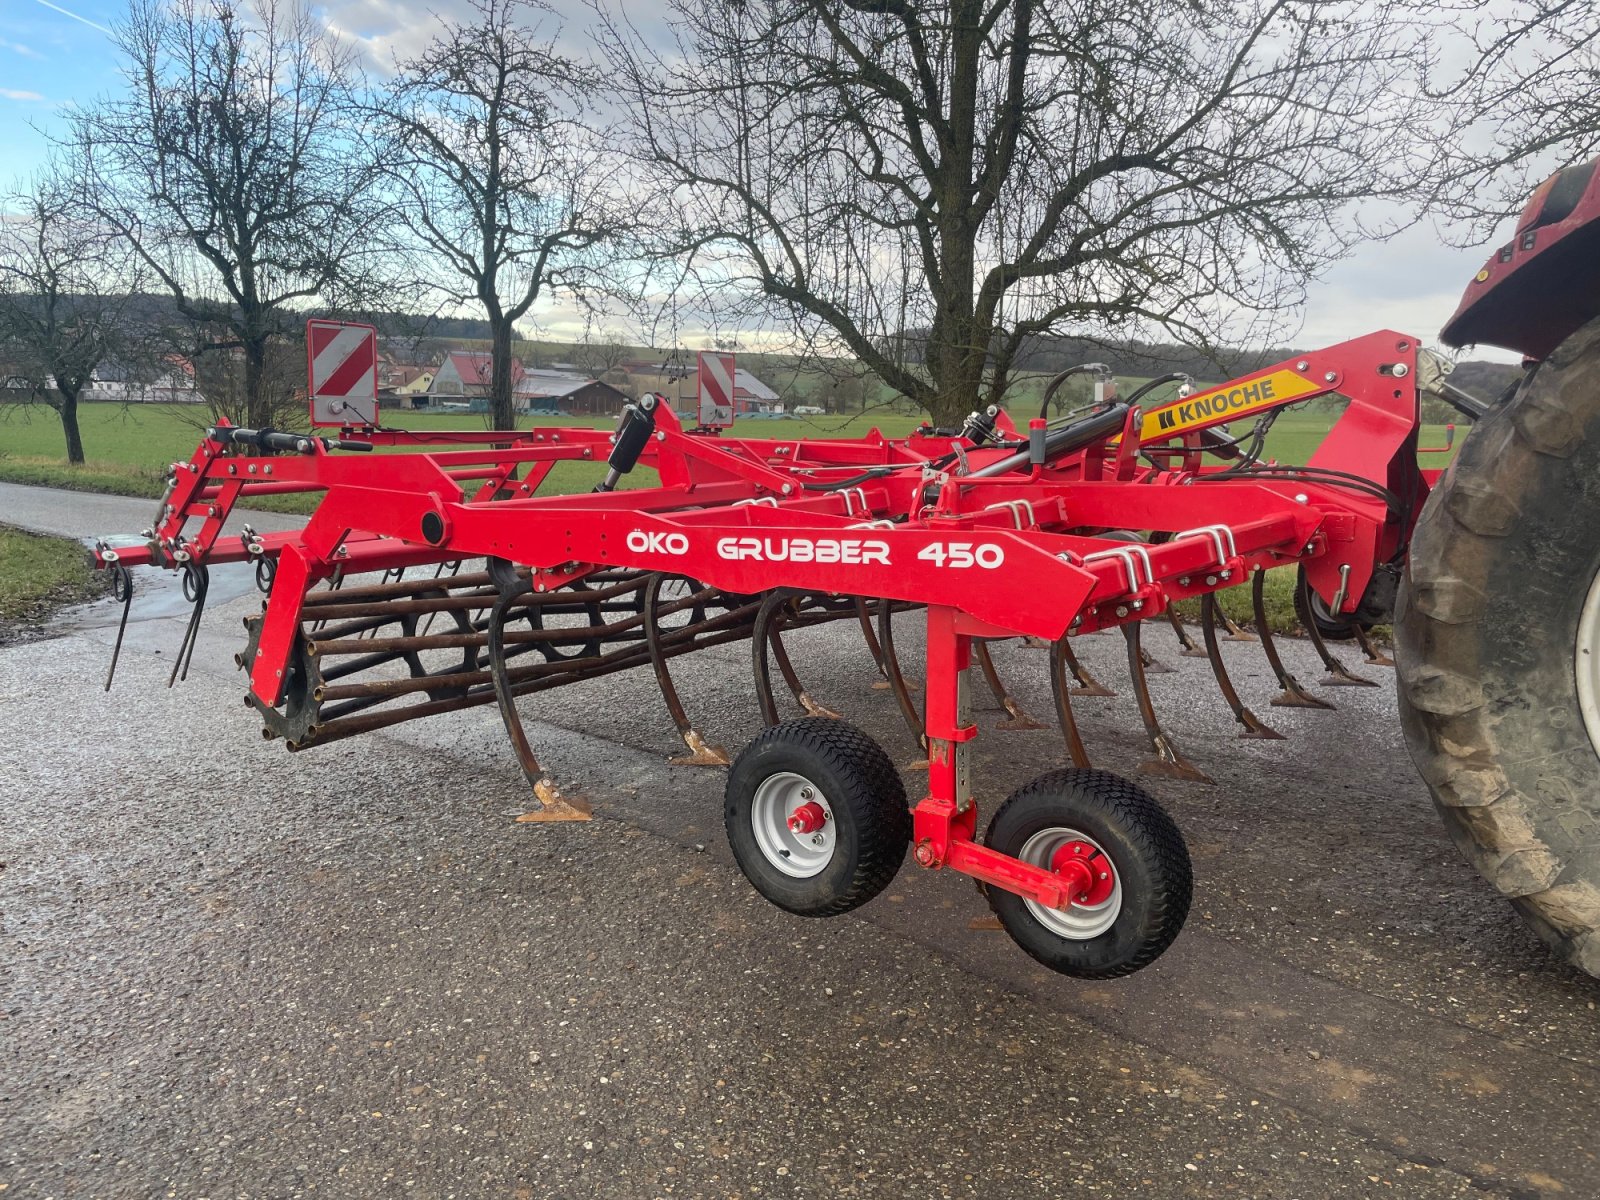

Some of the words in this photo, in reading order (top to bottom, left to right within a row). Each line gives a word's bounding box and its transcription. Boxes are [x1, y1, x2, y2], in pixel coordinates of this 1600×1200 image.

[1178, 379, 1276, 423] KNOCHE
[627, 528, 689, 555] ÖKO
[716, 537, 892, 565] GRUBBER
[917, 542, 1004, 569] 450
